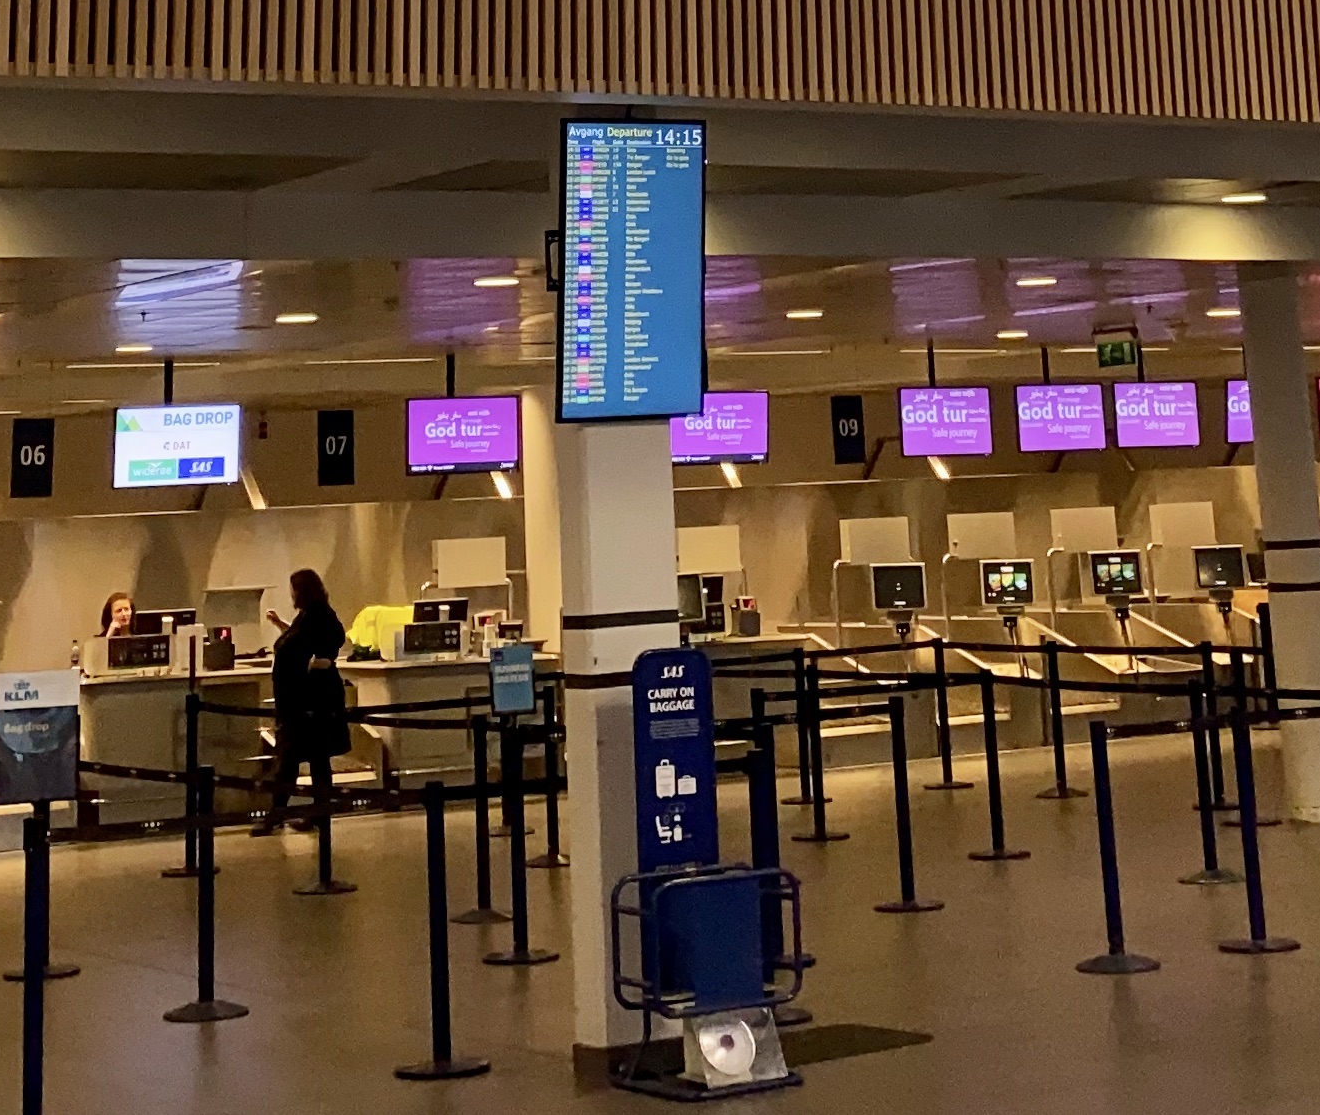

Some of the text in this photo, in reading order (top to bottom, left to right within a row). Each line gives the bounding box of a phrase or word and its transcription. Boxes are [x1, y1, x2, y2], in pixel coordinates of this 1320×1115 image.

[569, 126, 603, 138] Avgang
[607, 127, 653, 138] Departure
[655, 129, 702, 146] 14:15
[1018, 401, 1082, 420] God tur
[1116, 398, 1177, 417] God tur
[1228, 395, 1250, 413] Go
[163, 411, 233, 426] BAG DROP
[684, 415, 736, 430] God tur
[901, 405, 968, 424] God tur
[425, 422, 482, 437] God tur
[839, 418, 859, 437] 09
[325, 436, 347, 455] 07
[20, 445, 47, 466] 06
[189, 461, 213, 473] SAS
[661, 665, 685, 678] SAS
[4, 690, 38, 701] KLM
[648, 687, 694, 699] CARRY ON
[650, 699, 695, 713] BAGGAGE
